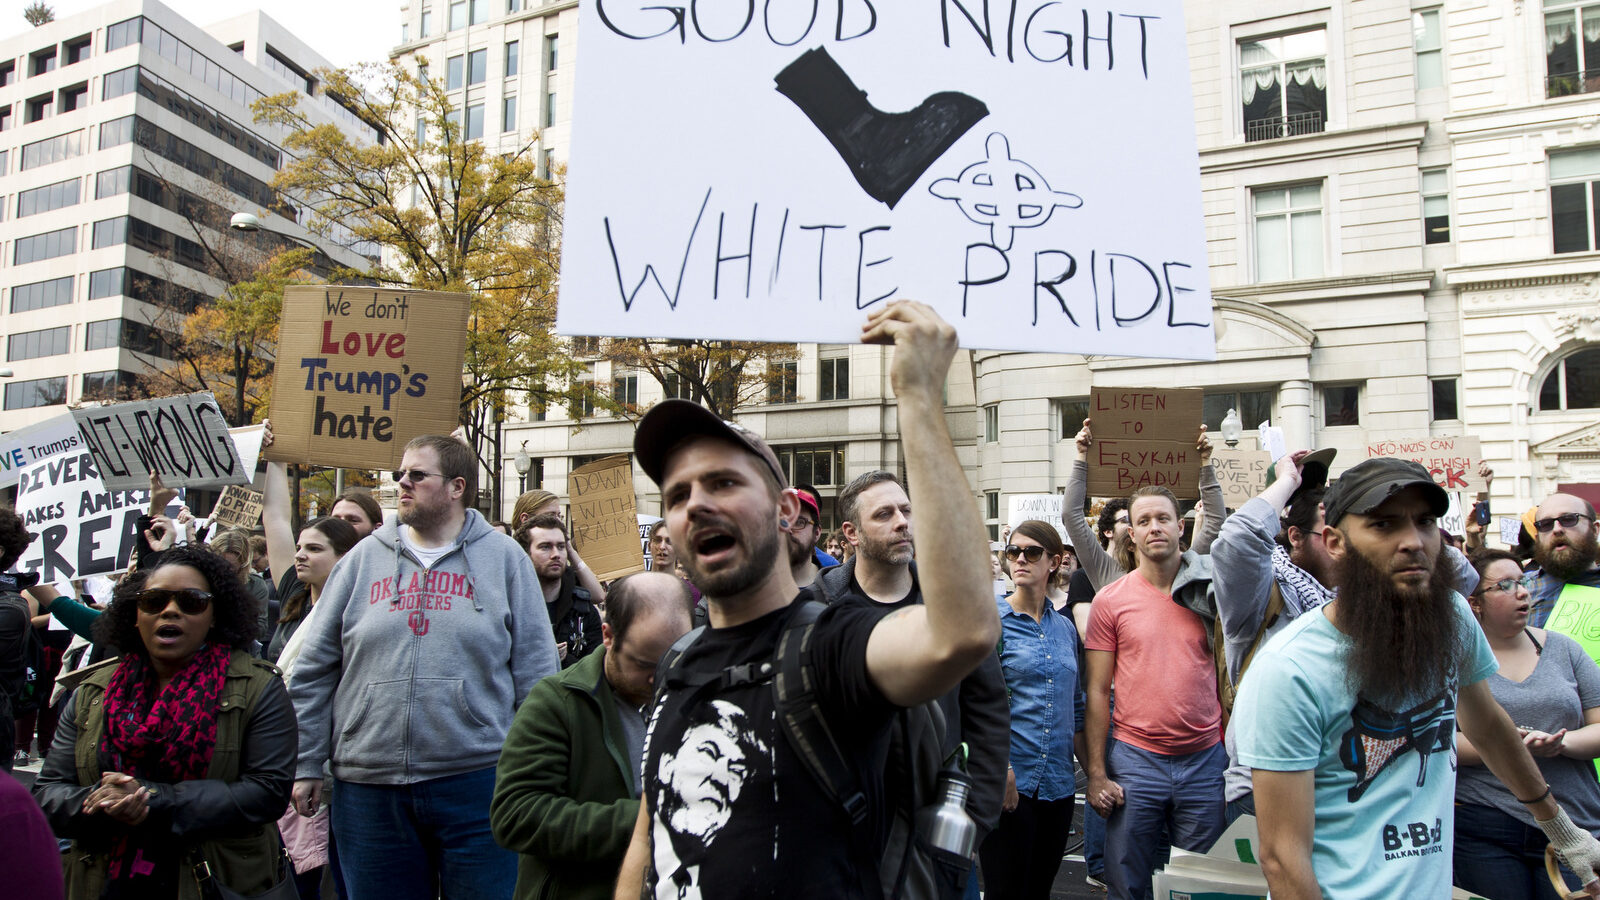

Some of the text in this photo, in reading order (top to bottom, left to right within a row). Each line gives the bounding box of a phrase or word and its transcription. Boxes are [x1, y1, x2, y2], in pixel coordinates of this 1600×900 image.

[596, 0, 1162, 80] GOOD NIGHT
[604, 187, 1210, 331] WHITE PRIDE
[326, 291, 409, 320] We don't
[320, 320, 407, 359] Love
[301, 358, 429, 411] Trump's
[1097, 393, 1167, 412] LISTEN
[313, 396, 393, 443] hate
[1121, 421, 1144, 435] TO
[0, 448, 27, 472] VE
[1099, 441, 1187, 468] ERYKAH
[1367, 440, 1455, 457] NEO-NAZIS CAN
[19, 453, 99, 497] DIVER
[1211, 458, 1265, 472] OVE IS
[1427, 457, 1471, 470] JEWISH
[574, 465, 627, 496] DOWN
[1118, 468, 1181, 490] BADU
[1216, 471, 1249, 483] OVE
[22, 502, 65, 527] AKES
[580, 494, 633, 520] WITH
[578, 513, 638, 547] RACISM
[1384, 849, 1420, 862] BALKAN
